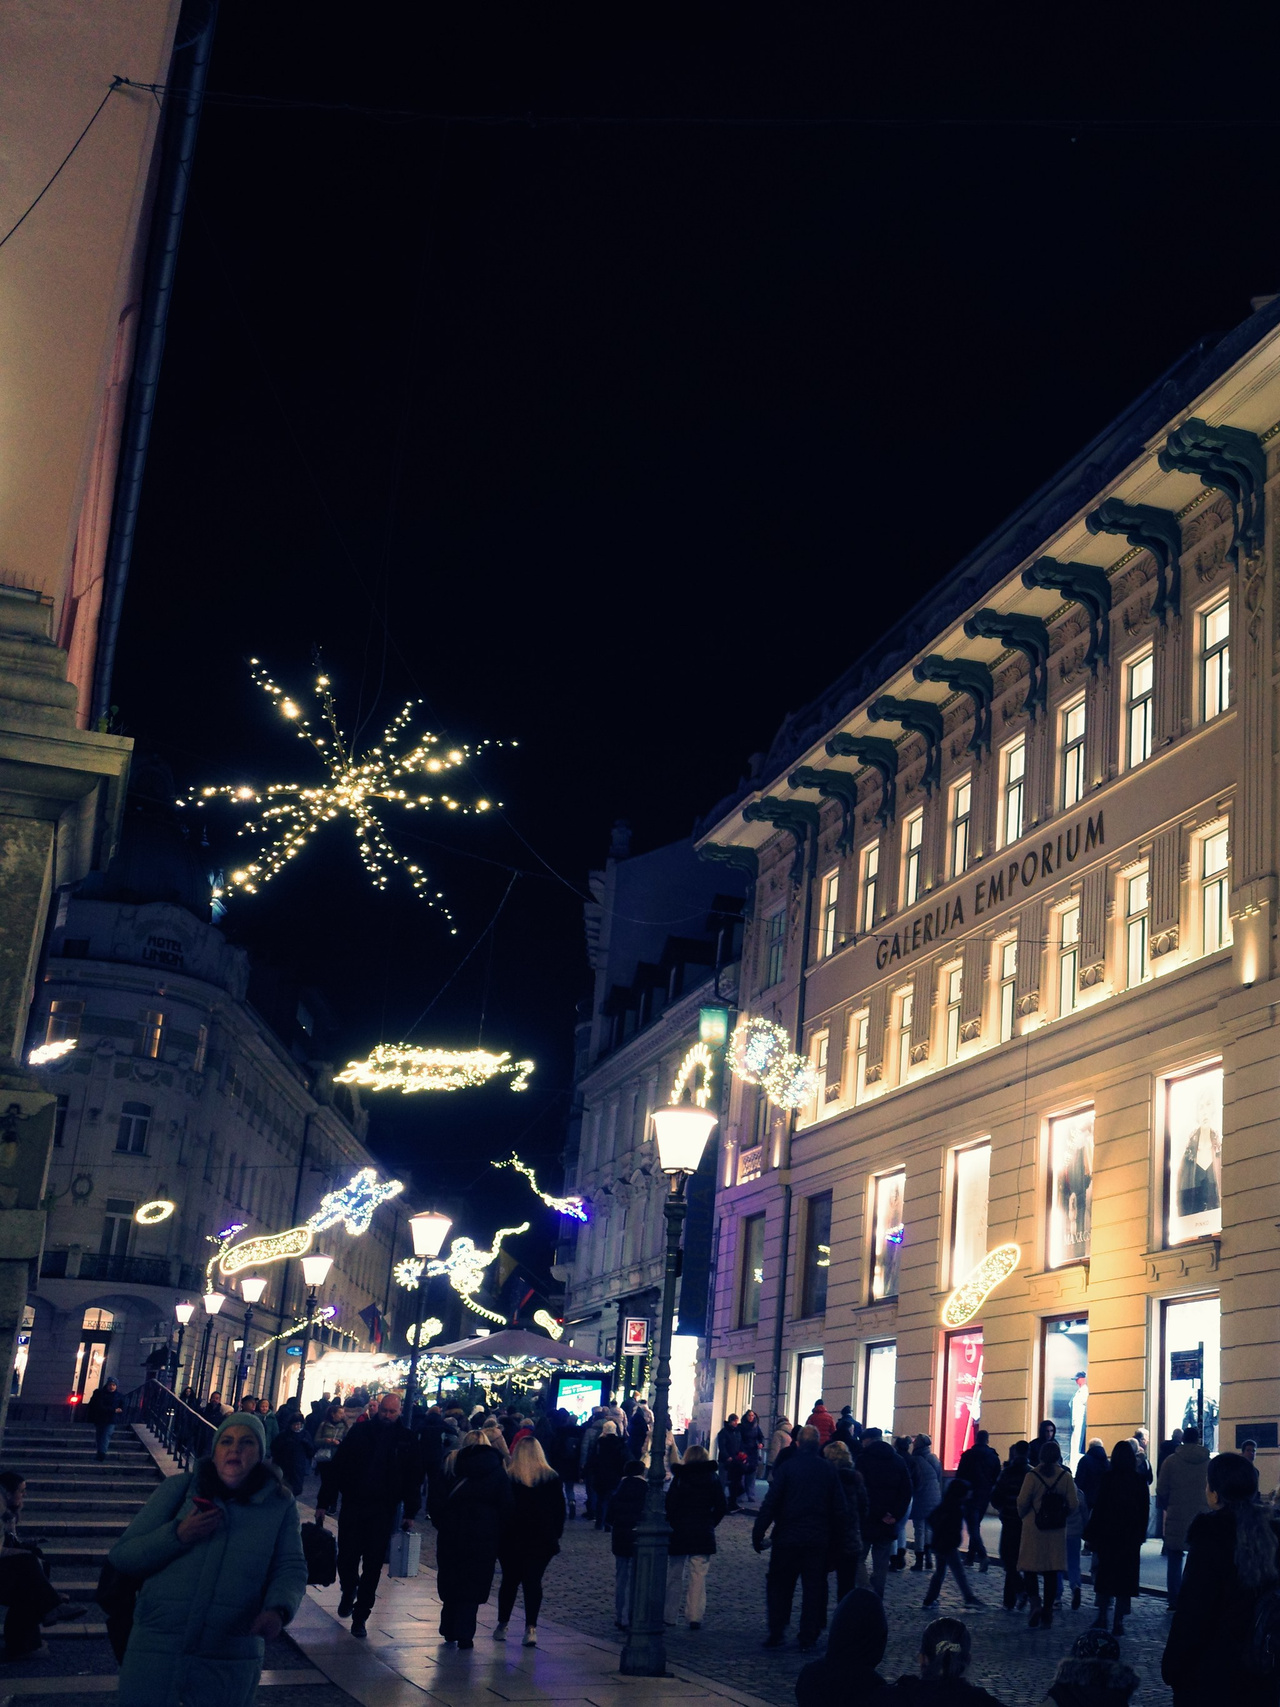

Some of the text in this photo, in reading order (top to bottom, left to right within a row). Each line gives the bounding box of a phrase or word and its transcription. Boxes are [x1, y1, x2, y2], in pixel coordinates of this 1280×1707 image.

[876, 810, 1105, 971] GALERIJA EMPORIUM
[147, 935, 183, 953] HOTEL
[142, 947, 184, 968] UNION
